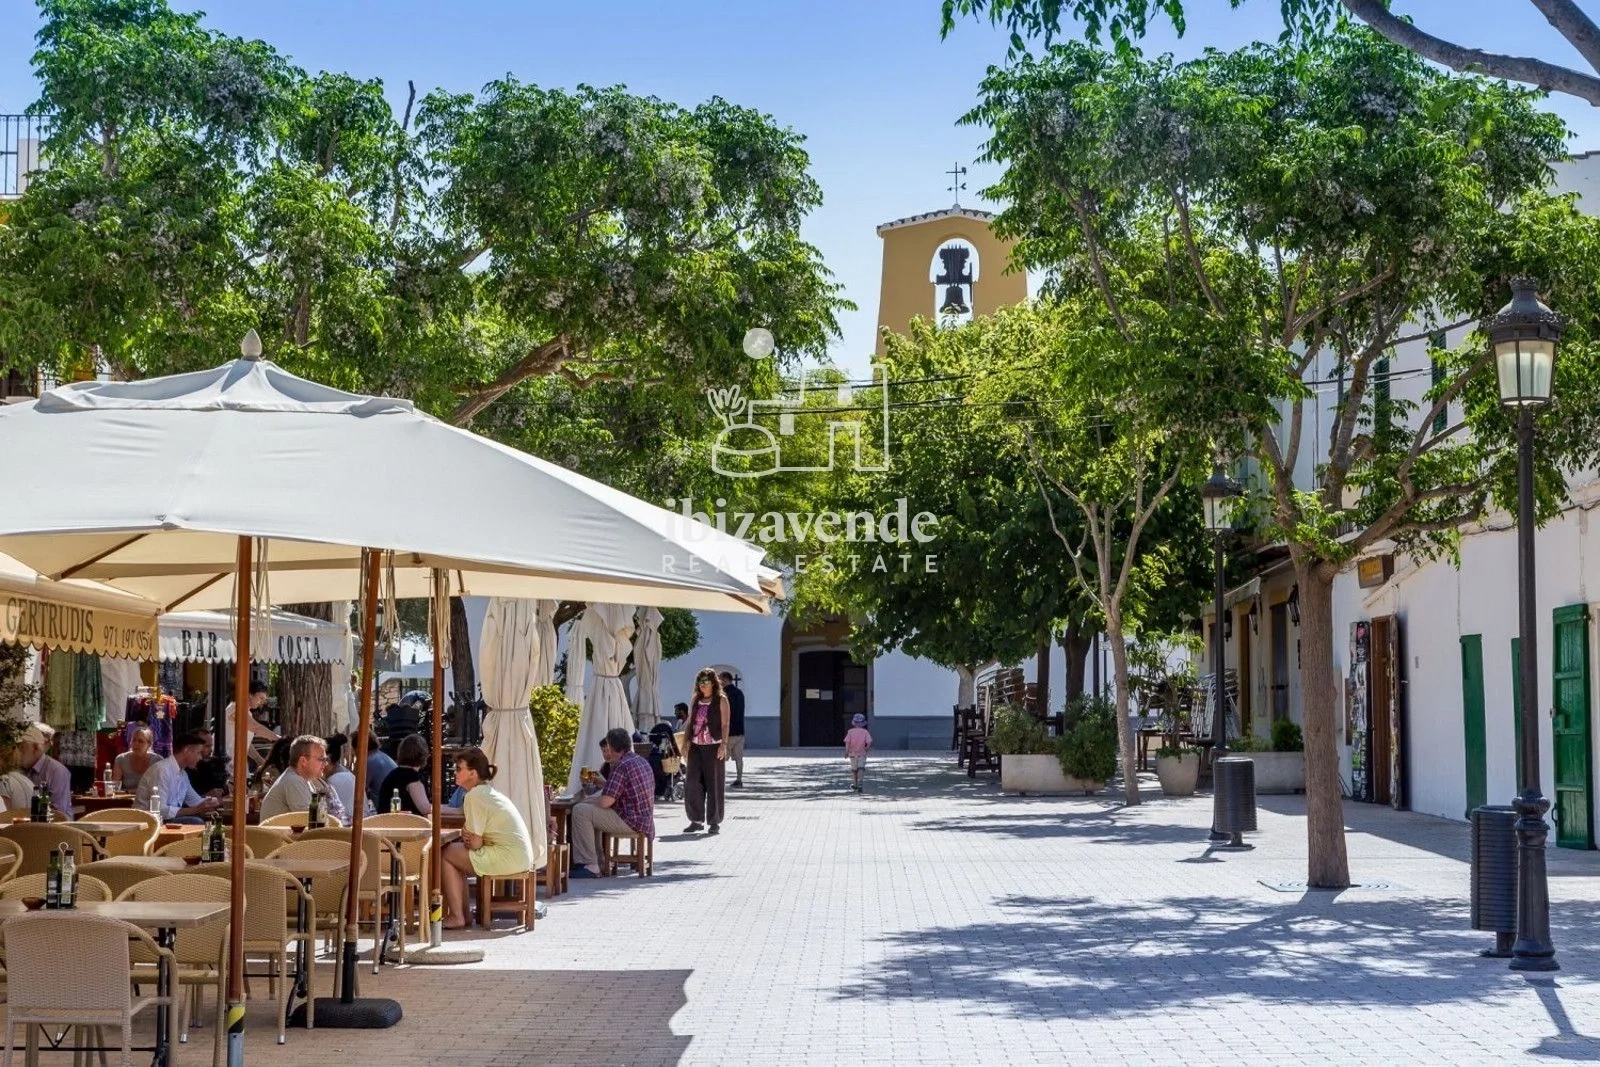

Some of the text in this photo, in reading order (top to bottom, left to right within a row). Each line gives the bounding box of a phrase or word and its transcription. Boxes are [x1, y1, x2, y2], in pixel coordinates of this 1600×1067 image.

[6, 597, 94, 645] GERTRUDIS
[103, 625, 118, 648] 971
[122, 628, 135, 649] 197
[181, 629, 321, 660] BAR COSTA
